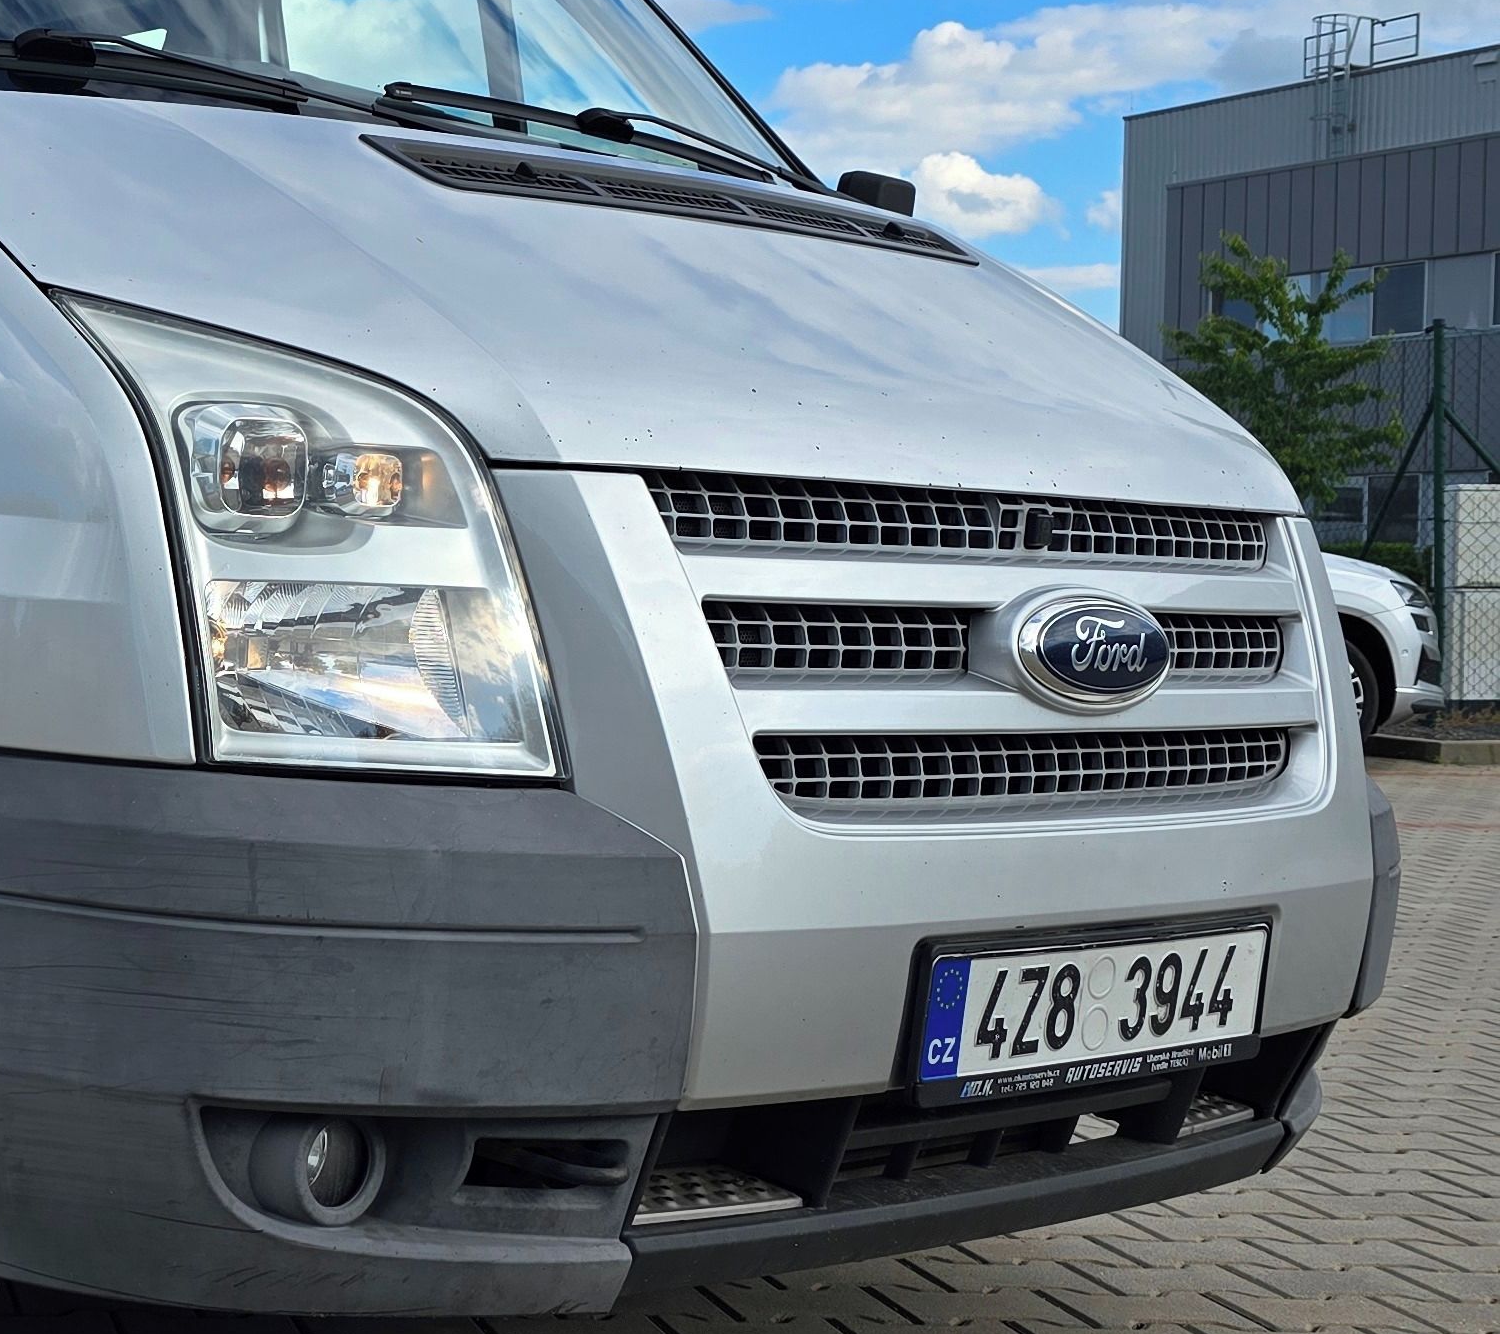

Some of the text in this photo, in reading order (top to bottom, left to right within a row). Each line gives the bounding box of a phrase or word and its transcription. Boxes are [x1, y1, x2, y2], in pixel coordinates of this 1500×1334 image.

[1071, 615, 1148, 672] Ford
[973, 943, 1238, 1061] 4Z8 3944
[927, 1036, 955, 1066] CZ
[1064, 1056, 1143, 1084] AUTOSERVIS
[1198, 1044, 1223, 1062] Mobil
